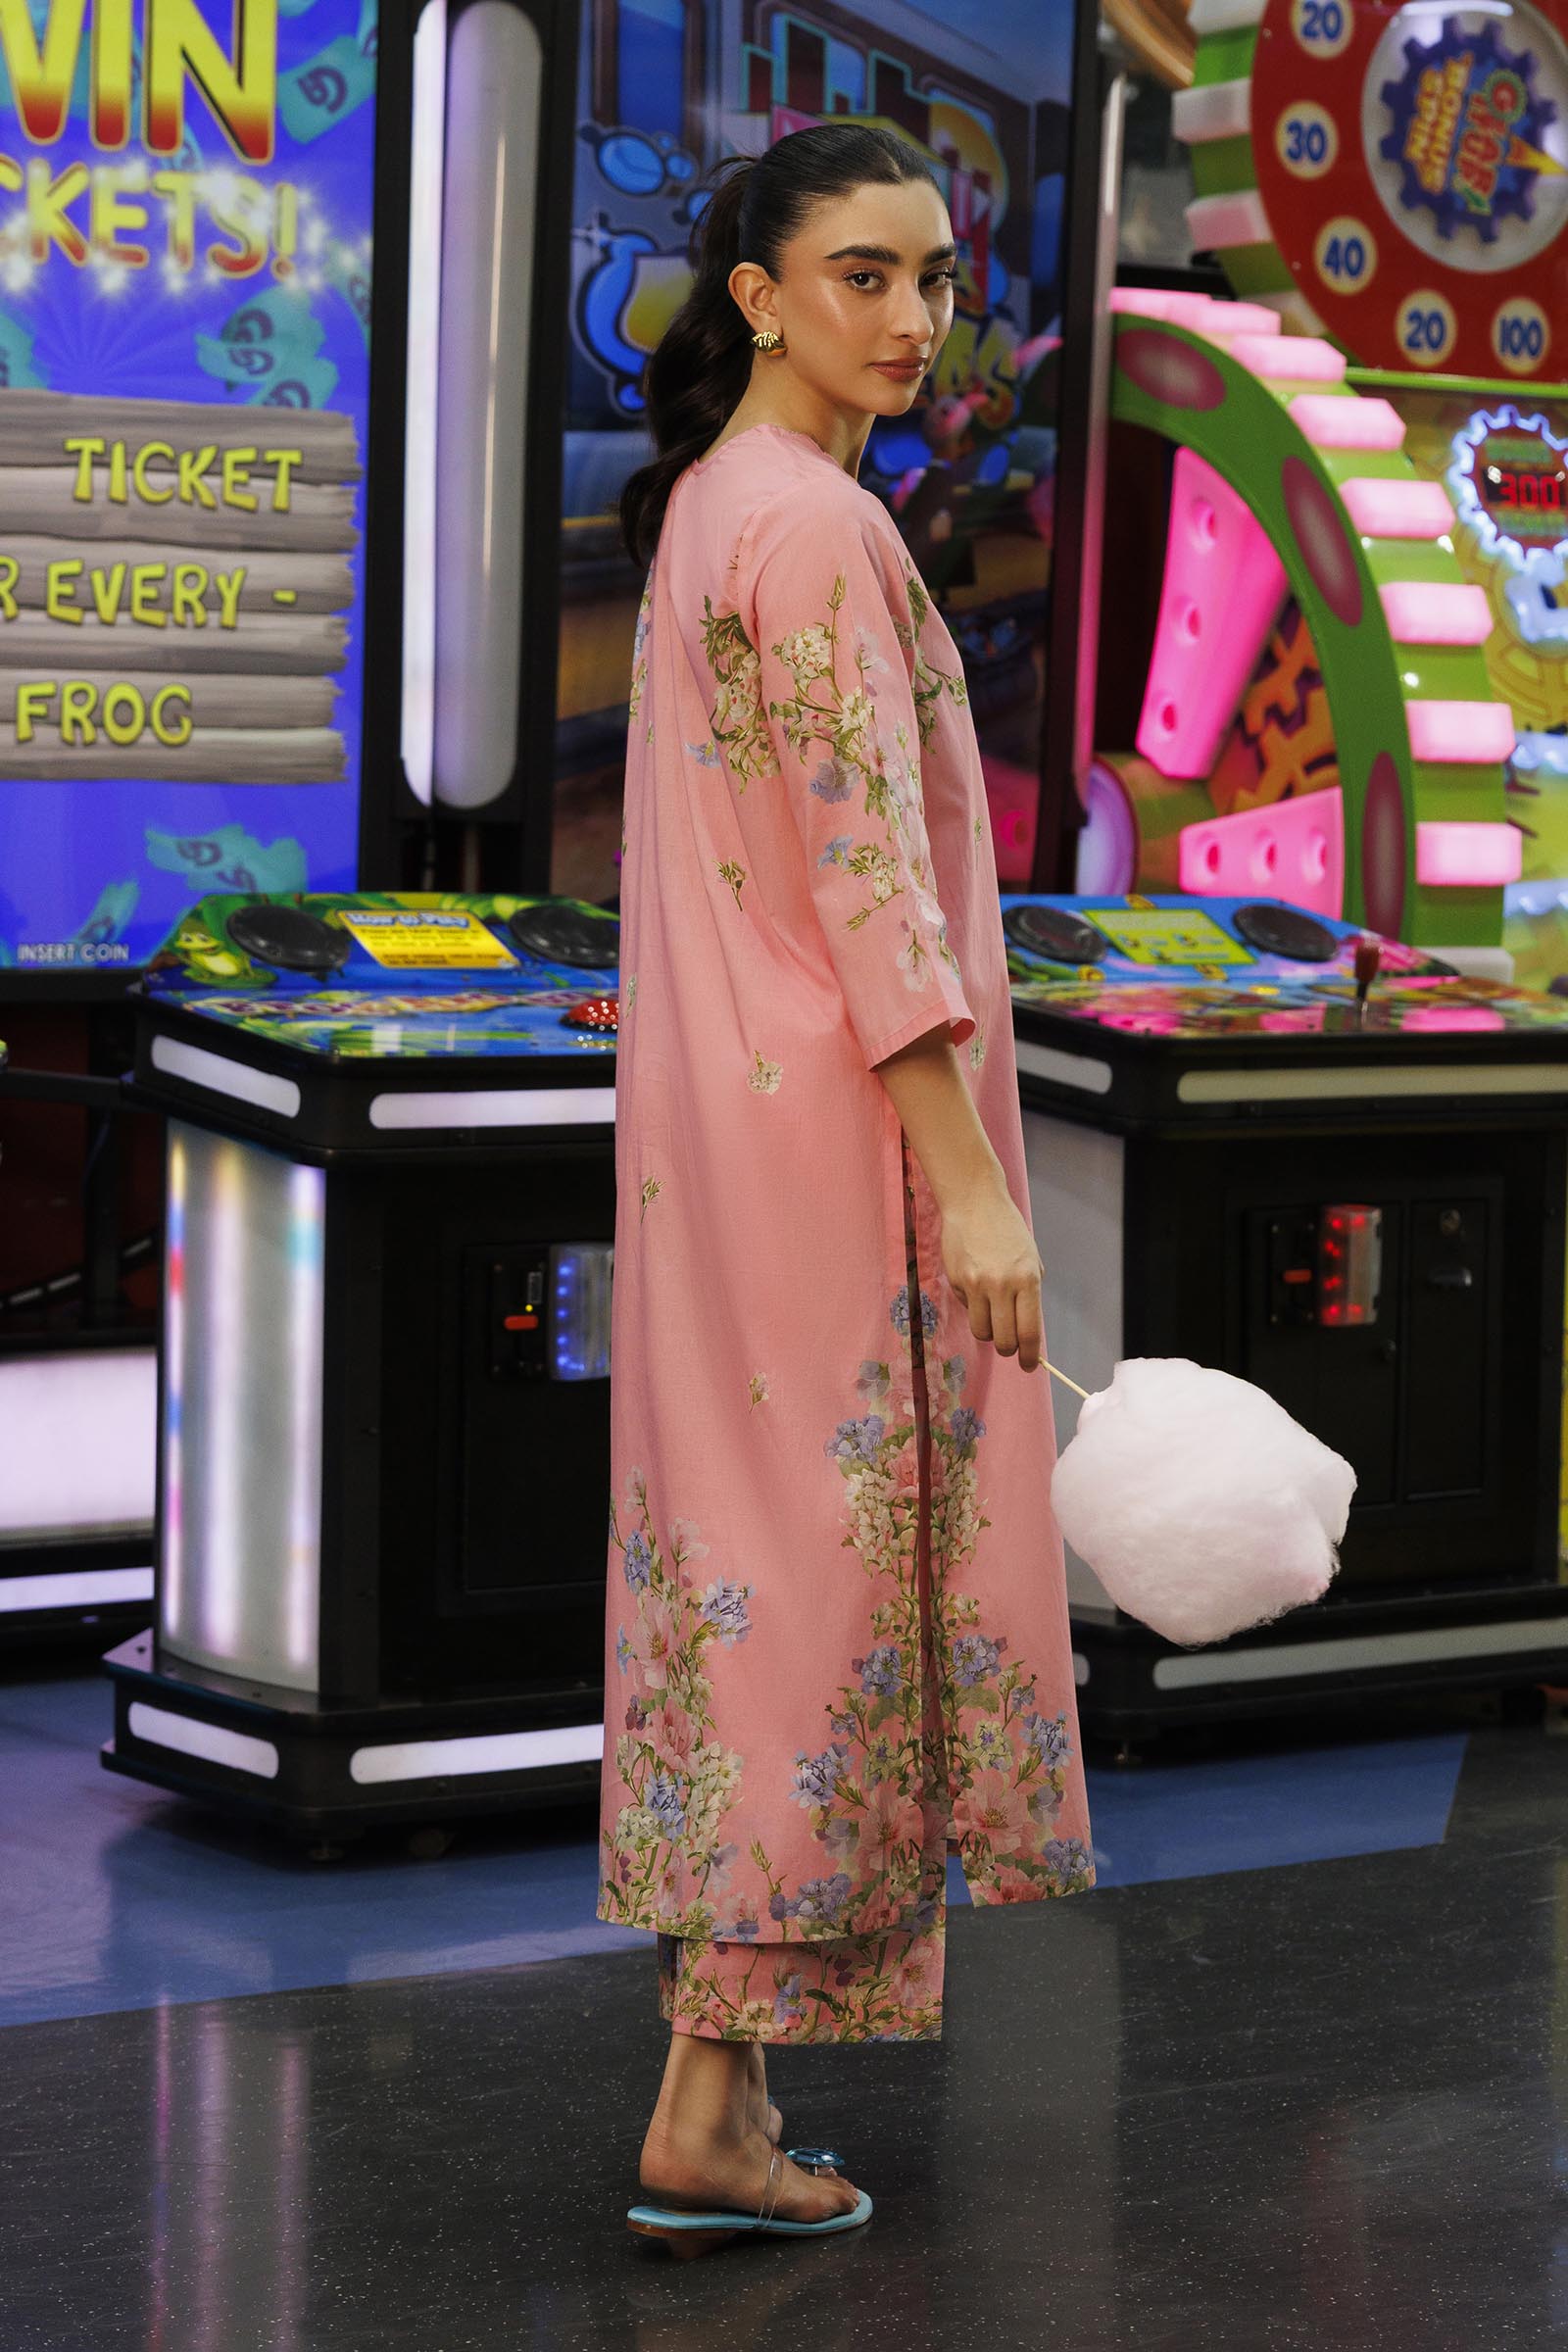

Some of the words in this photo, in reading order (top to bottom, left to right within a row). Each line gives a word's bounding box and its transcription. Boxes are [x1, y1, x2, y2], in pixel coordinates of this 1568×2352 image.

[1300, 0, 1343, 41] 20
[1286, 119, 1328, 164] 30
[1324, 235, 1365, 277] 40
[1405, 310, 1446, 351] 20
[1498, 316, 1544, 358] 100
[64, 437, 303, 513] TICKET
[47, 558, 247, 629] EVERY
[16, 680, 194, 747] FROG
[17, 943, 75, 961] INSERT
[80, 943, 129, 962] COIN
